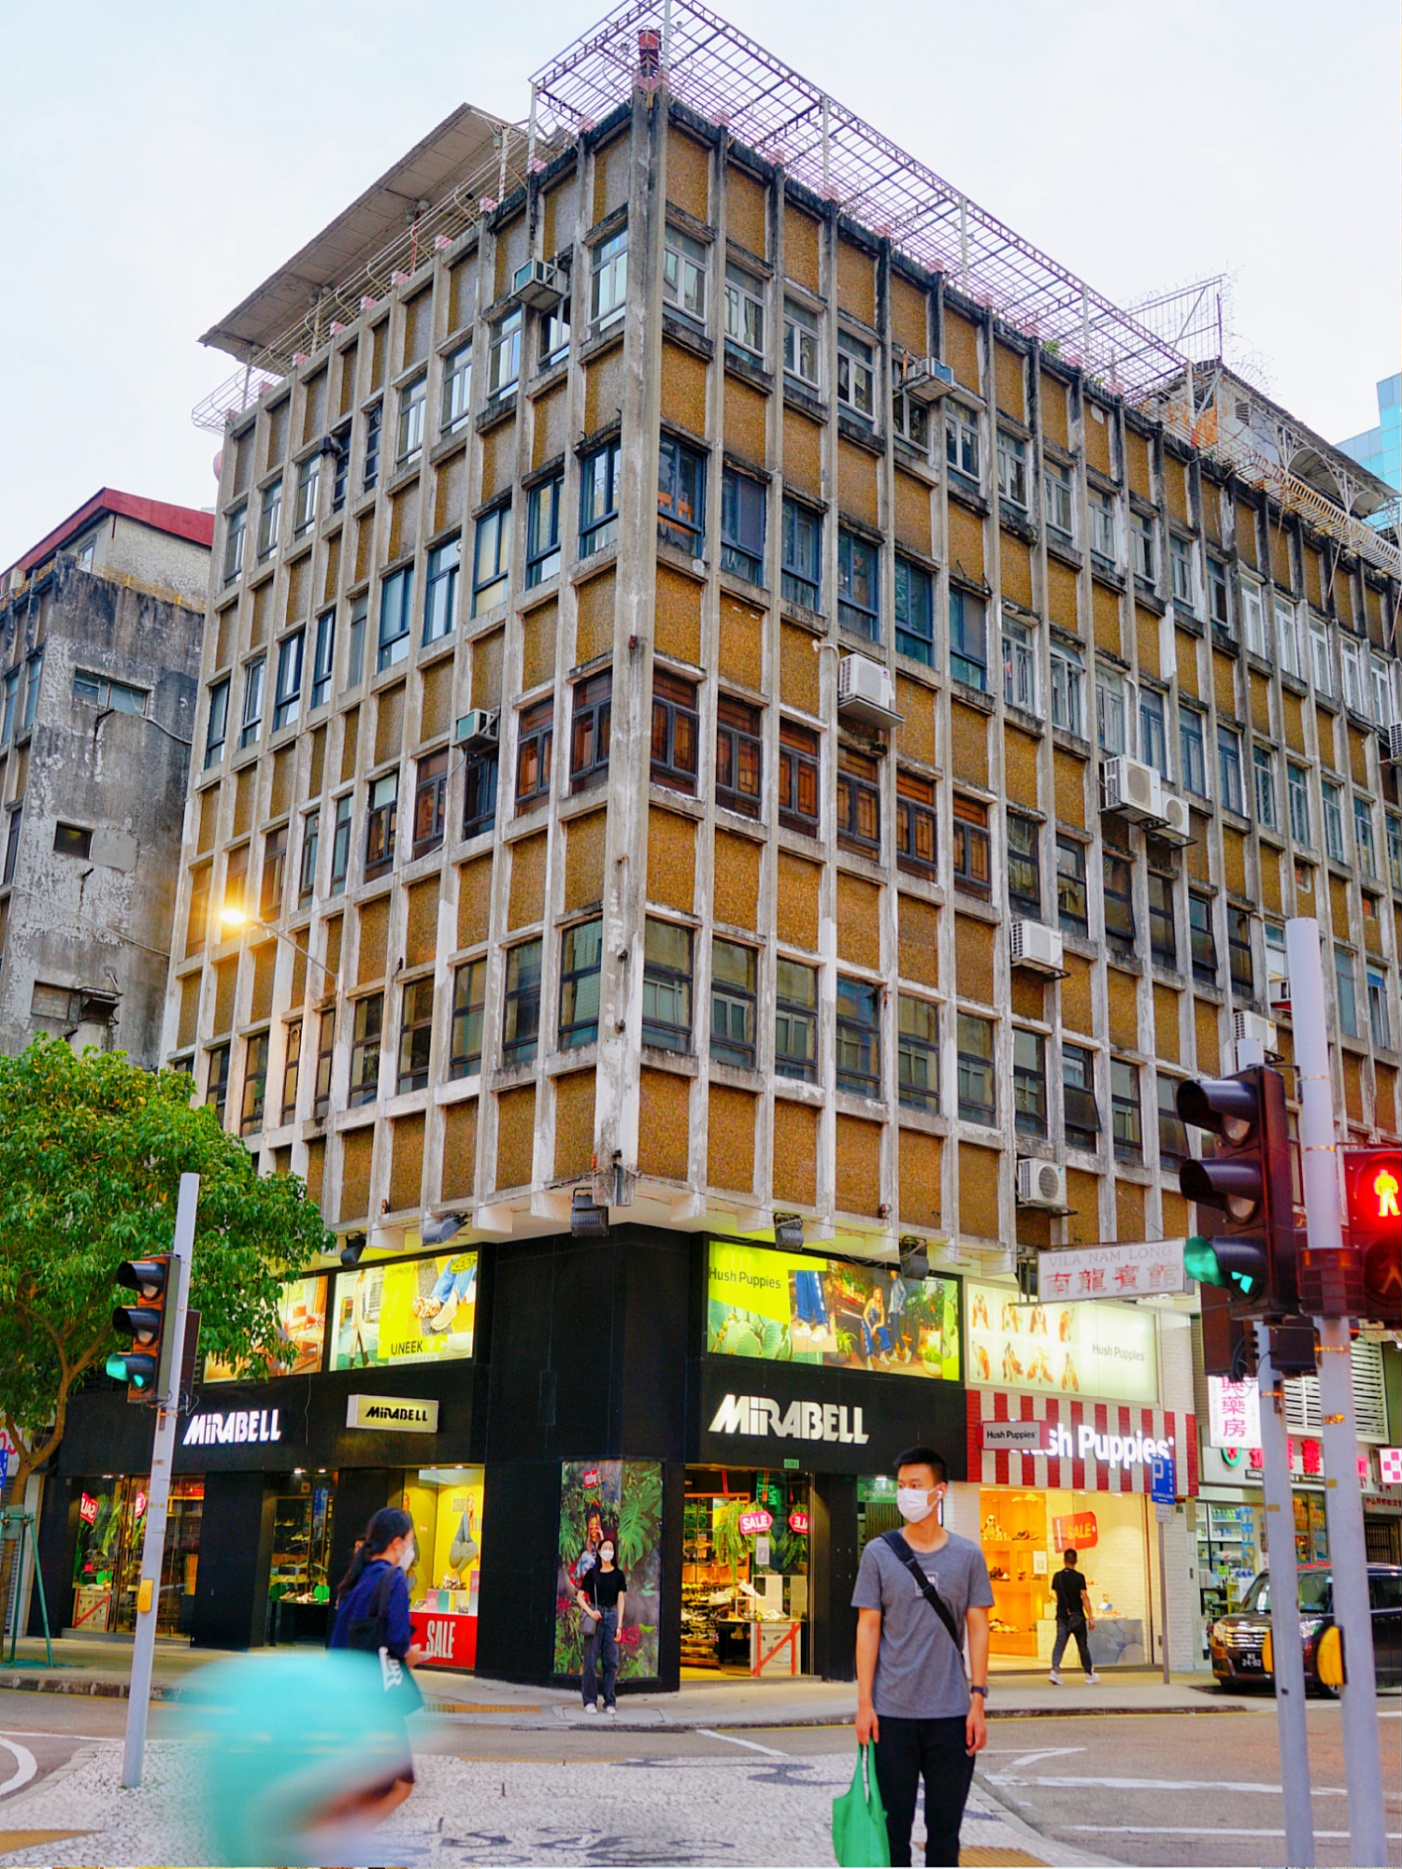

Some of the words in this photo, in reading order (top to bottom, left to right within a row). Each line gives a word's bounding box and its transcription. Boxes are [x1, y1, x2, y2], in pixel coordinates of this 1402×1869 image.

[1049, 1256, 1081, 1268] VILA
[1088, 1251, 1121, 1264] NAM
[1129, 1244, 1173, 1260] LONG
[708, 1267, 737, 1282] Hush
[738, 1271, 782, 1290] Puppies
[1044, 1262, 1180, 1296] 南龍賓館
[390, 1340, 424, 1356] UNEEK
[1092, 1343, 1113, 1356] Hush
[1113, 1346, 1145, 1362] Puppies
[986, 1430, 1005, 1440] Hush
[1006, 1429, 1037, 1440] Puppies
[1077, 1424, 1174, 1470] Puppies
[1151, 1459, 1165, 1491] P
[742, 1514, 768, 1531] SALE
[1066, 1522, 1092, 1541] SALE
[425, 1620, 456, 1660] SALE
